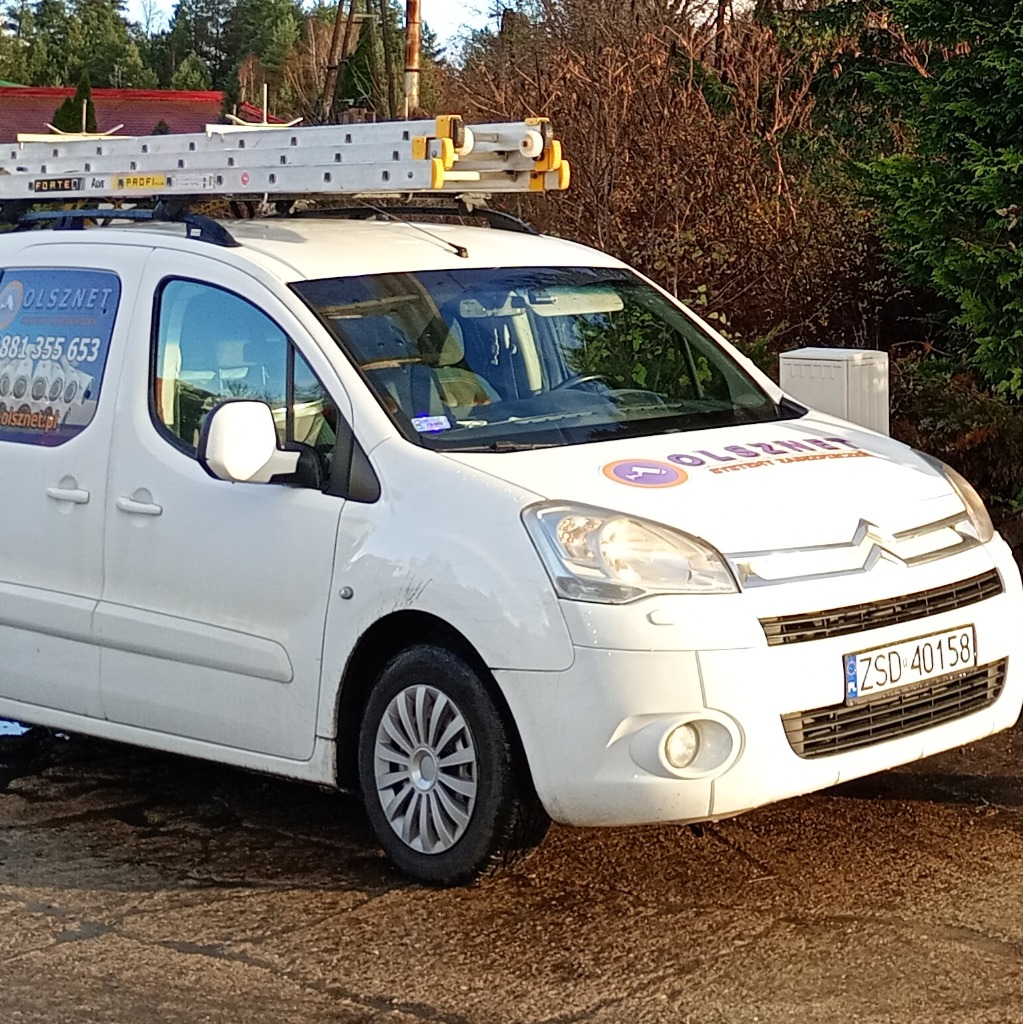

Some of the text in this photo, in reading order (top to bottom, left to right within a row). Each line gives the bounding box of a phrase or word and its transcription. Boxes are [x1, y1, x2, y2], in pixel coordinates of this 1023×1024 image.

[23, 288, 112, 308] OLSZNET
[0, 335, 101, 362] 881 355 653
[667, 438, 859, 466] OLSZNET
[860, 650, 902, 691] ZSD
[911, 633, 971, 676] 40158
